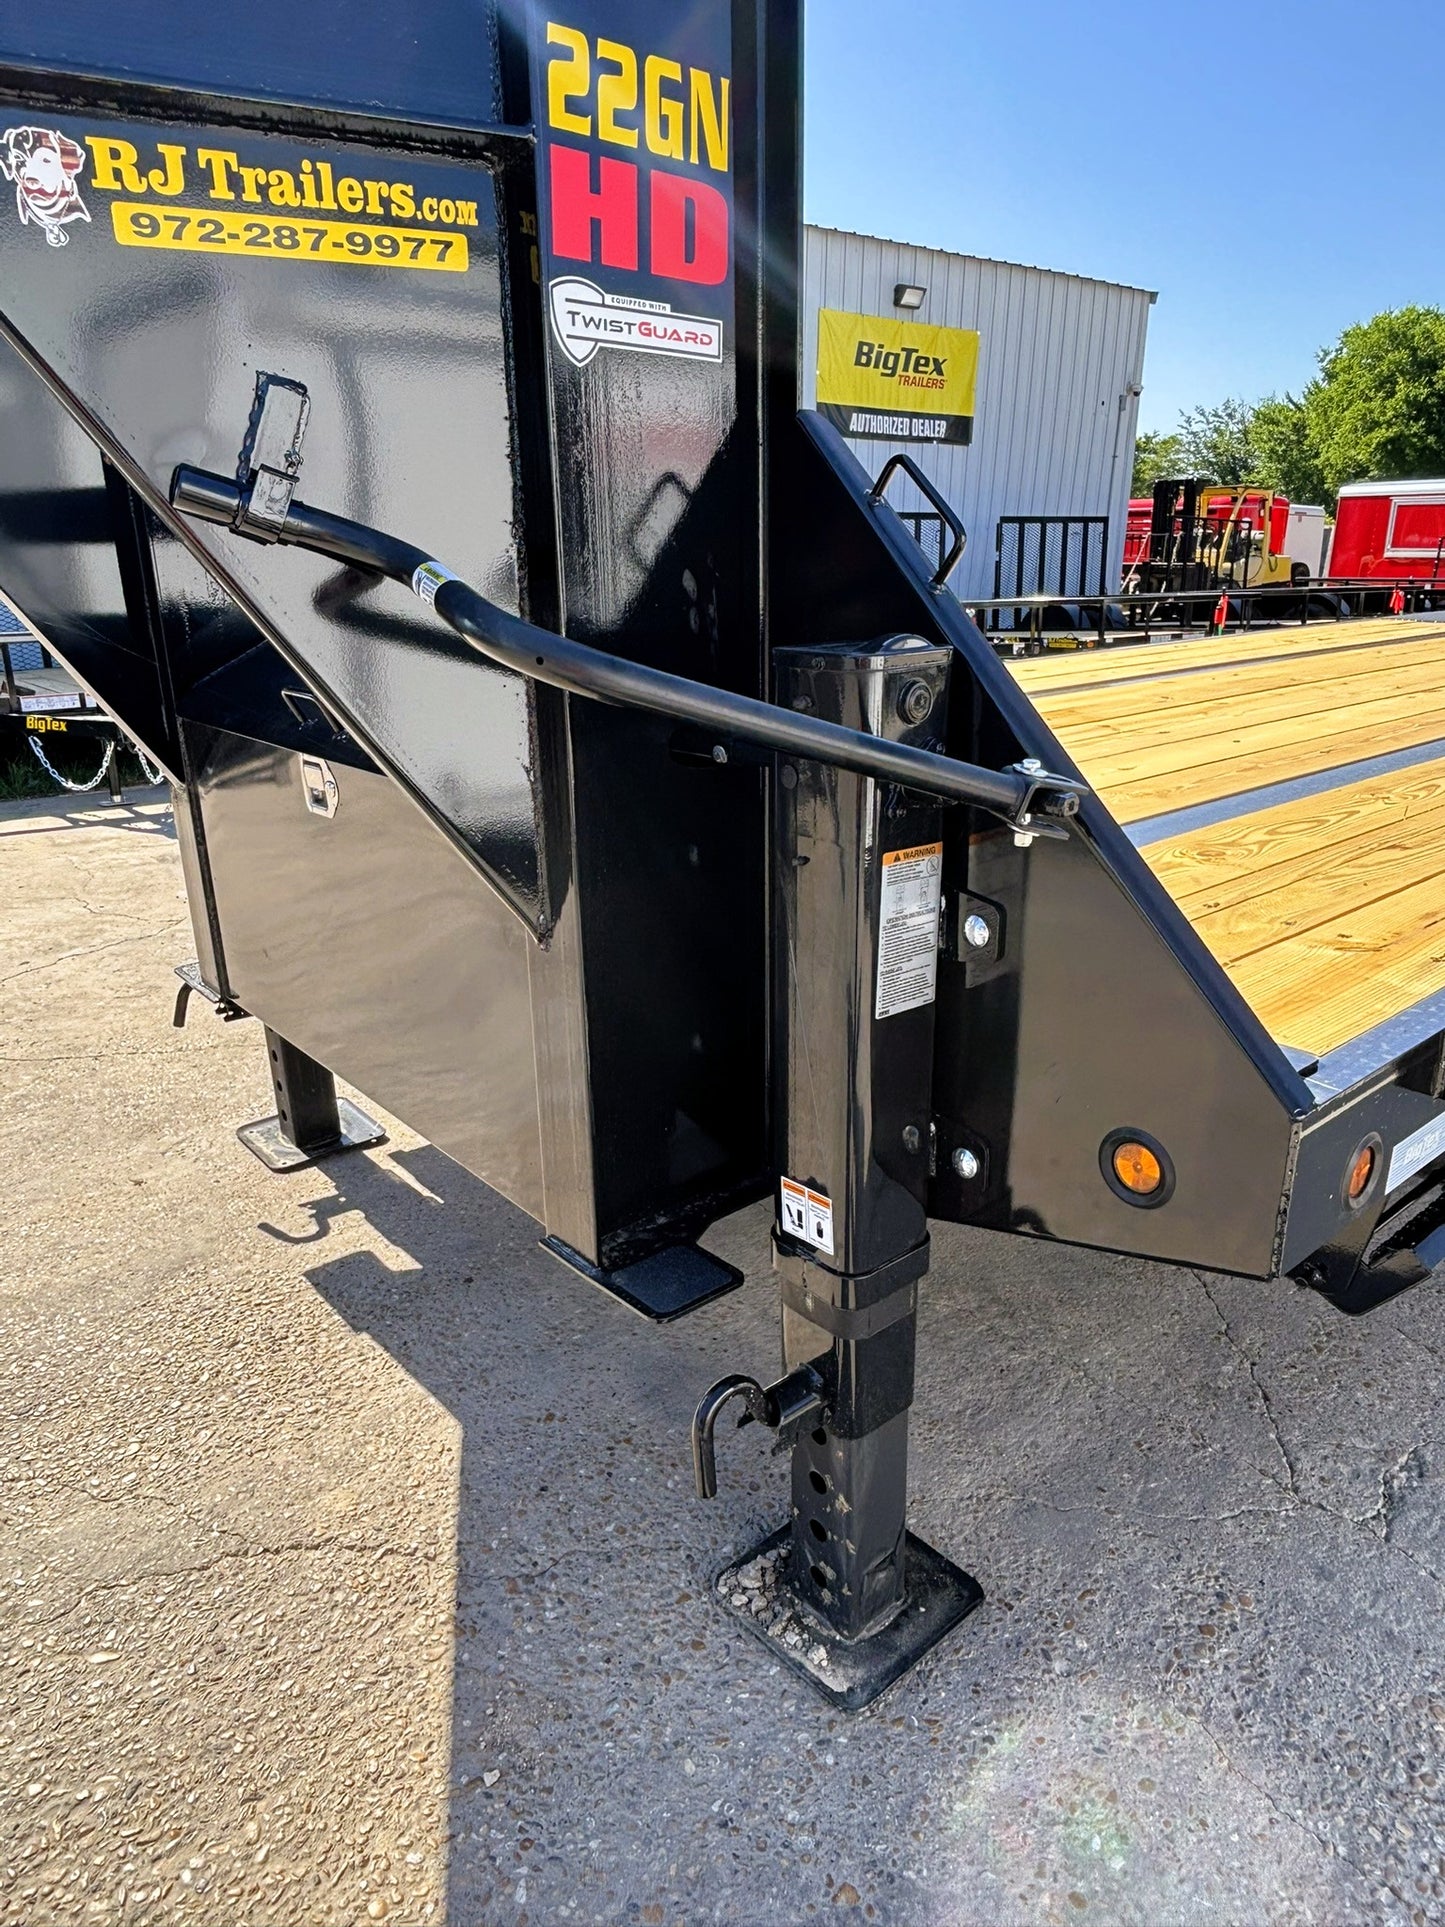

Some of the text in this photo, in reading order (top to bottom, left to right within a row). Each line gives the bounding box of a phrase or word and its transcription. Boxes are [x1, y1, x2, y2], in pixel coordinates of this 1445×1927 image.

[547, 21, 730, 172] 22GN
[85, 136, 187, 196] RJ
[550, 143, 729, 286] HD
[130, 212, 454, 263] 972-287-9977
[611, 296, 667, 312] EQUIPPED WITH
[854, 341, 948, 378] BigTex
[898, 374, 945, 390] TRAILERS
[850, 413, 947, 438] AUTHORIZED DEALER
[26, 715, 68, 733] BigTex
[902, 846, 936, 860] WARNING
